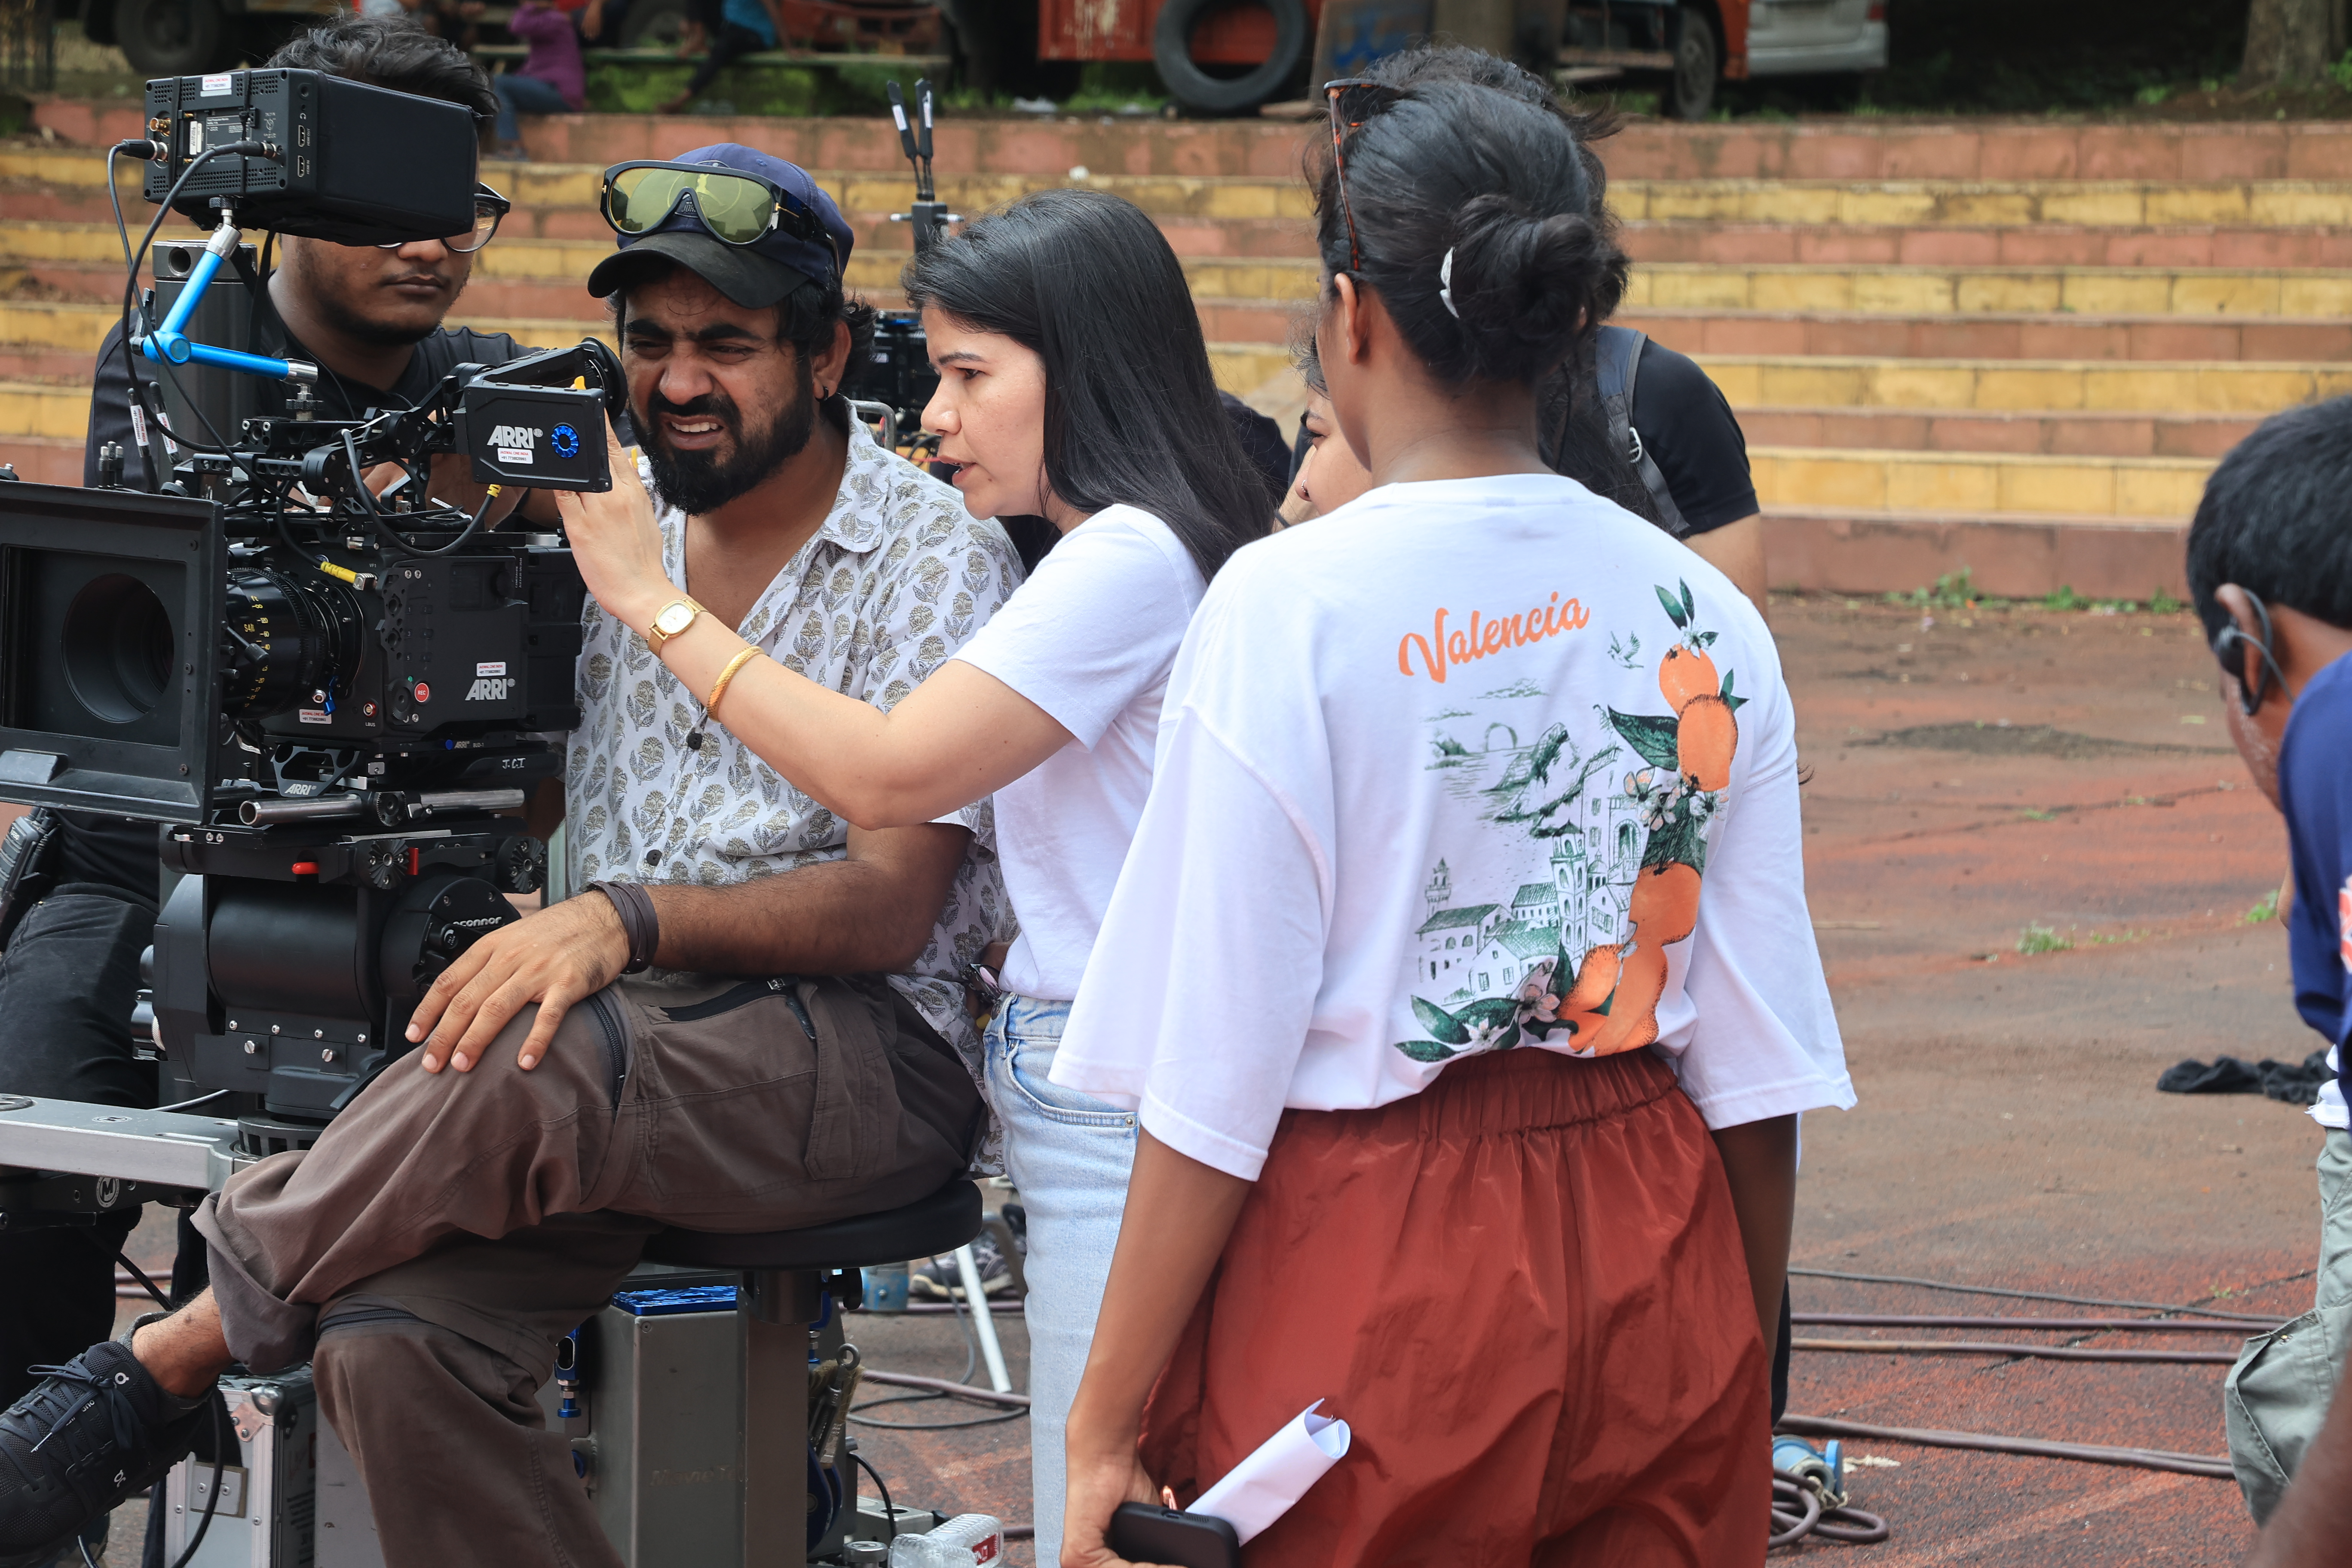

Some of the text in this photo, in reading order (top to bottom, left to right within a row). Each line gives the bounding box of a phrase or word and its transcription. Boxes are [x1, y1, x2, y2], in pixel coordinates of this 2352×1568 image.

[487, 425, 535, 449] ARRI
[1398, 591, 1590, 684] Valencia
[465, 678, 507, 701] ARRI
[284, 784, 312, 796] ARRI
